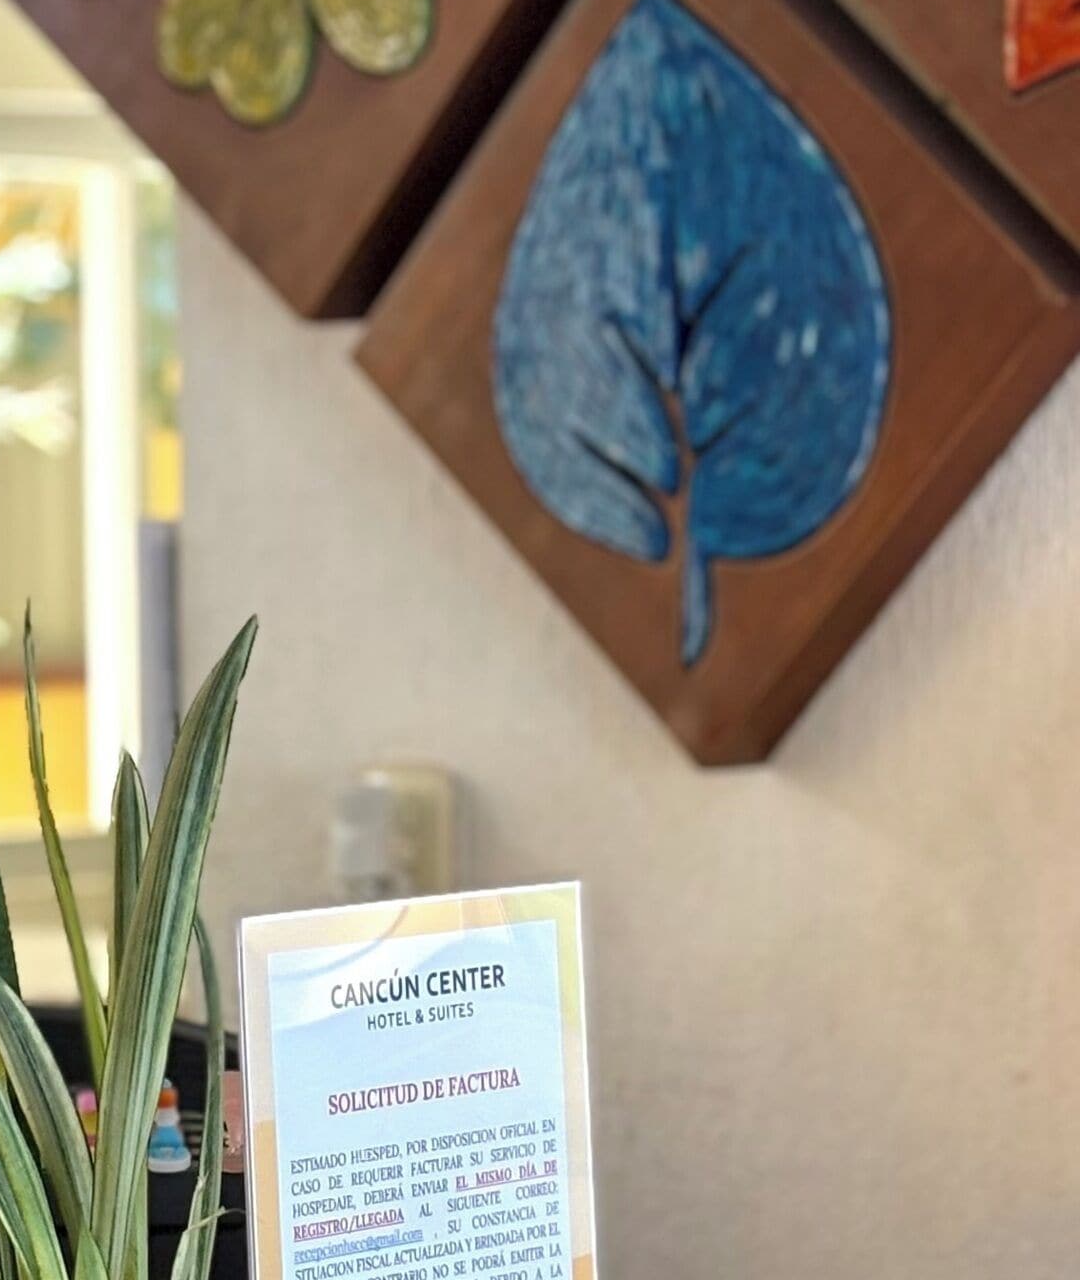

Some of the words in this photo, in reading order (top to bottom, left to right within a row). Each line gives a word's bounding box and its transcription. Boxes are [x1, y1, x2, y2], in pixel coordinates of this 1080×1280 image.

[331, 968, 420, 1008] CANCÚN
[426, 964, 506, 996] CENTER
[367, 1011, 411, 1030] HOTEL
[415, 1009, 424, 1024] &
[429, 1002, 474, 1022] SUITES
[328, 1083, 418, 1115] SOLICITUD
[423, 1079, 444, 1100] DE
[449, 1067, 521, 1096] FACTURA
[291, 1152, 347, 1174] ESTIMADO
[406, 1139, 427, 1155] POR
[432, 1128, 496, 1151] DISPOSICION
[500, 1121, 539, 1140] OFICIAL
[542, 1118, 556, 1133] EN
[292, 1178, 320, 1196] CASO
[329, 1175, 343, 1190] DE
[351, 1164, 404, 1186] REQUERIR
[411, 1154, 463, 1177] FACTURAR
[470, 1151, 483, 1166] SU
[491, 1142, 536, 1162] SERVICIO
[543, 1139, 556, 1154] DE
[292, 1194, 357, 1219] HOSPEDAJE,
[364, 1183, 404, 1206] DEBERÁ
[411, 1178, 448, 1197] ENVIAR
[456, 1176, 468, 1192] EL
[476, 1167, 512, 1189] MISMO
[519, 1161, 537, 1182] DÍA
[544, 1160, 558, 1178] DE
[293, 1208, 405, 1242] REGISTRO/LLEGADA
[419, 1203, 433, 1217] AL
[447, 1190, 502, 1212] SIGUIENTE
[294, 1229, 424, 1265] recepcionhscc@gmail.com
[448, 1219, 462, 1234] SU
[472, 1205, 536, 1230] CONSTANCIA
[546, 1201, 559, 1216] DE
[356, 1253, 392, 1273] FISCAL
[394, 1239, 464, 1265] ACTUALIZADA
[465, 1238, 474, 1252] Y
[474, 1229, 525, 1250] BRINDADA
[527, 1225, 546, 1240] POR
[548, 1222, 561, 1236] EL
[432, 1264, 449, 1280] NO
[454, 1260, 466, 1276] SE
[471, 1250, 505, 1272] PODRÁ
[511, 1246, 545, 1264] EMITIR
[549, 1242, 562, 1257] LA
[535, 1267, 543, 1280] A
[550, 1263, 563, 1278] LA
